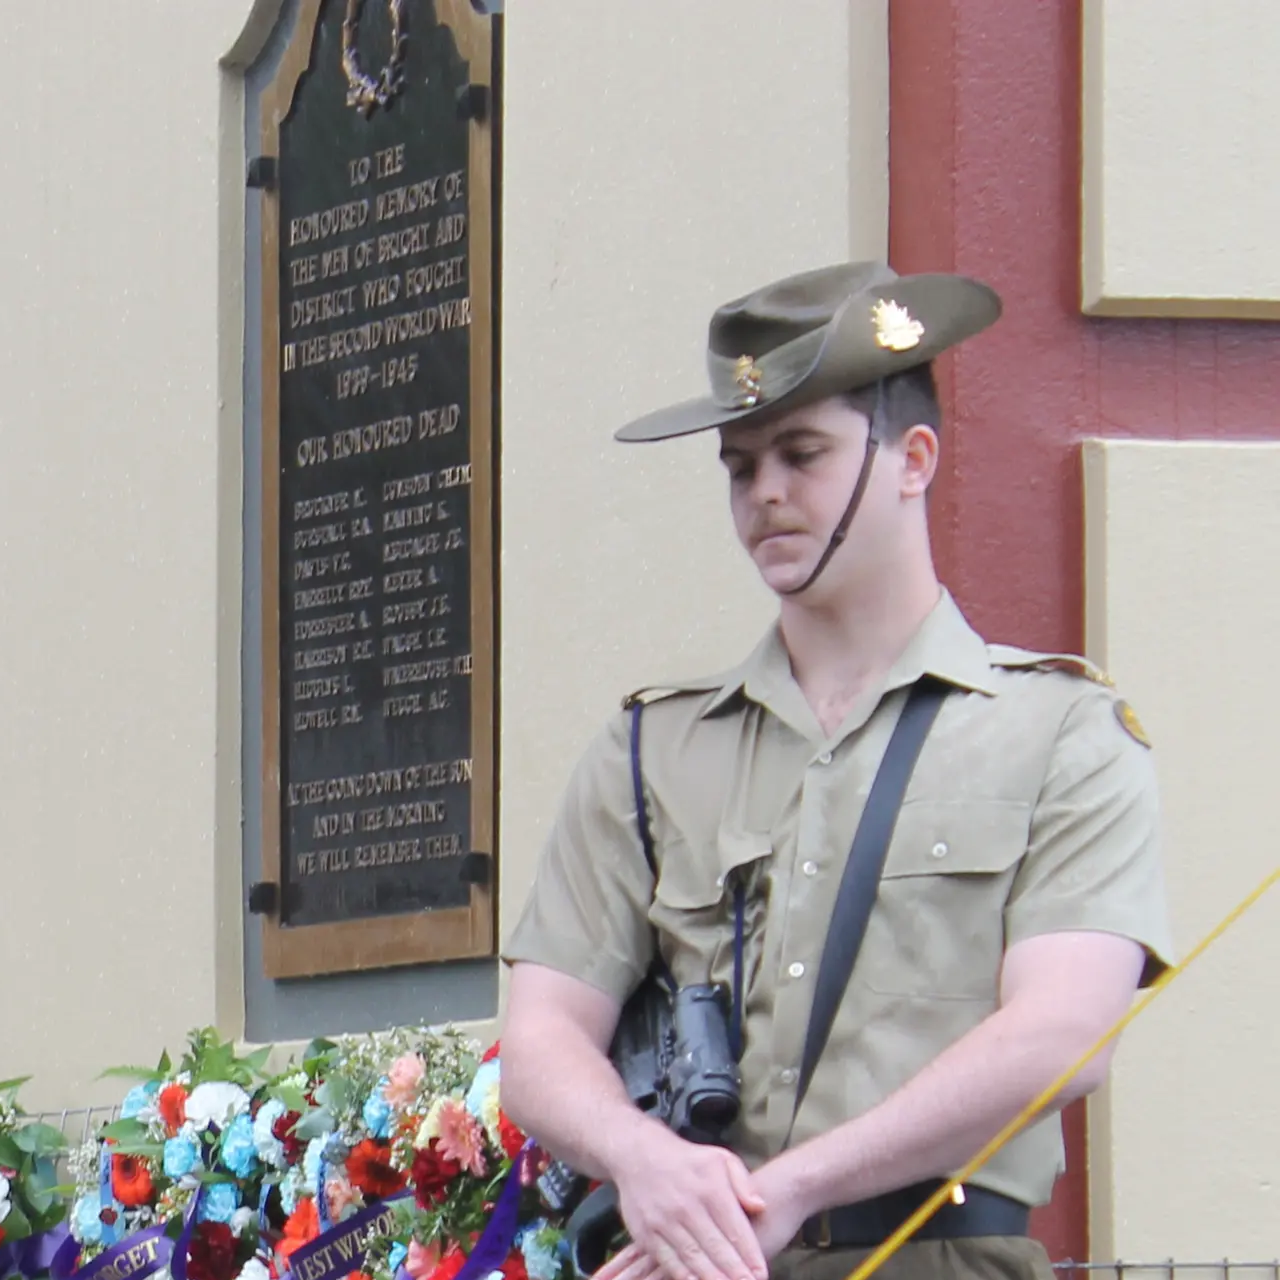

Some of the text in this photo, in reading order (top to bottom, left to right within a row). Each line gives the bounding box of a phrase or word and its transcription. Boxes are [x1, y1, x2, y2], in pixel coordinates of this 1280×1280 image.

[349, 143, 406, 186] TO THE
[290, 170, 464, 246] HONOURED MEMORY OF
[291, 214, 465, 286] THE MEN OF BRIGHT AND
[291, 257, 466, 328] DISTRICT WHO FOUGHT
[284, 297, 471, 371] IN THE SECOND WORLD WAR
[297, 404, 461, 467] OUR HONOURED DEAD
[302, 778, 324, 803] THE
[326, 770, 364, 799] GOING
[366, 764, 402, 797] DOWN
[406, 765, 422, 788] OF
[423, 762, 446, 787] THE
[448, 758, 473, 782] SUN
[313, 800, 447, 838] AND IN THE MORNING
[297, 851, 316, 875] WE
[318, 845, 352, 872] WILL
[355, 837, 422, 867] REMEMBER
